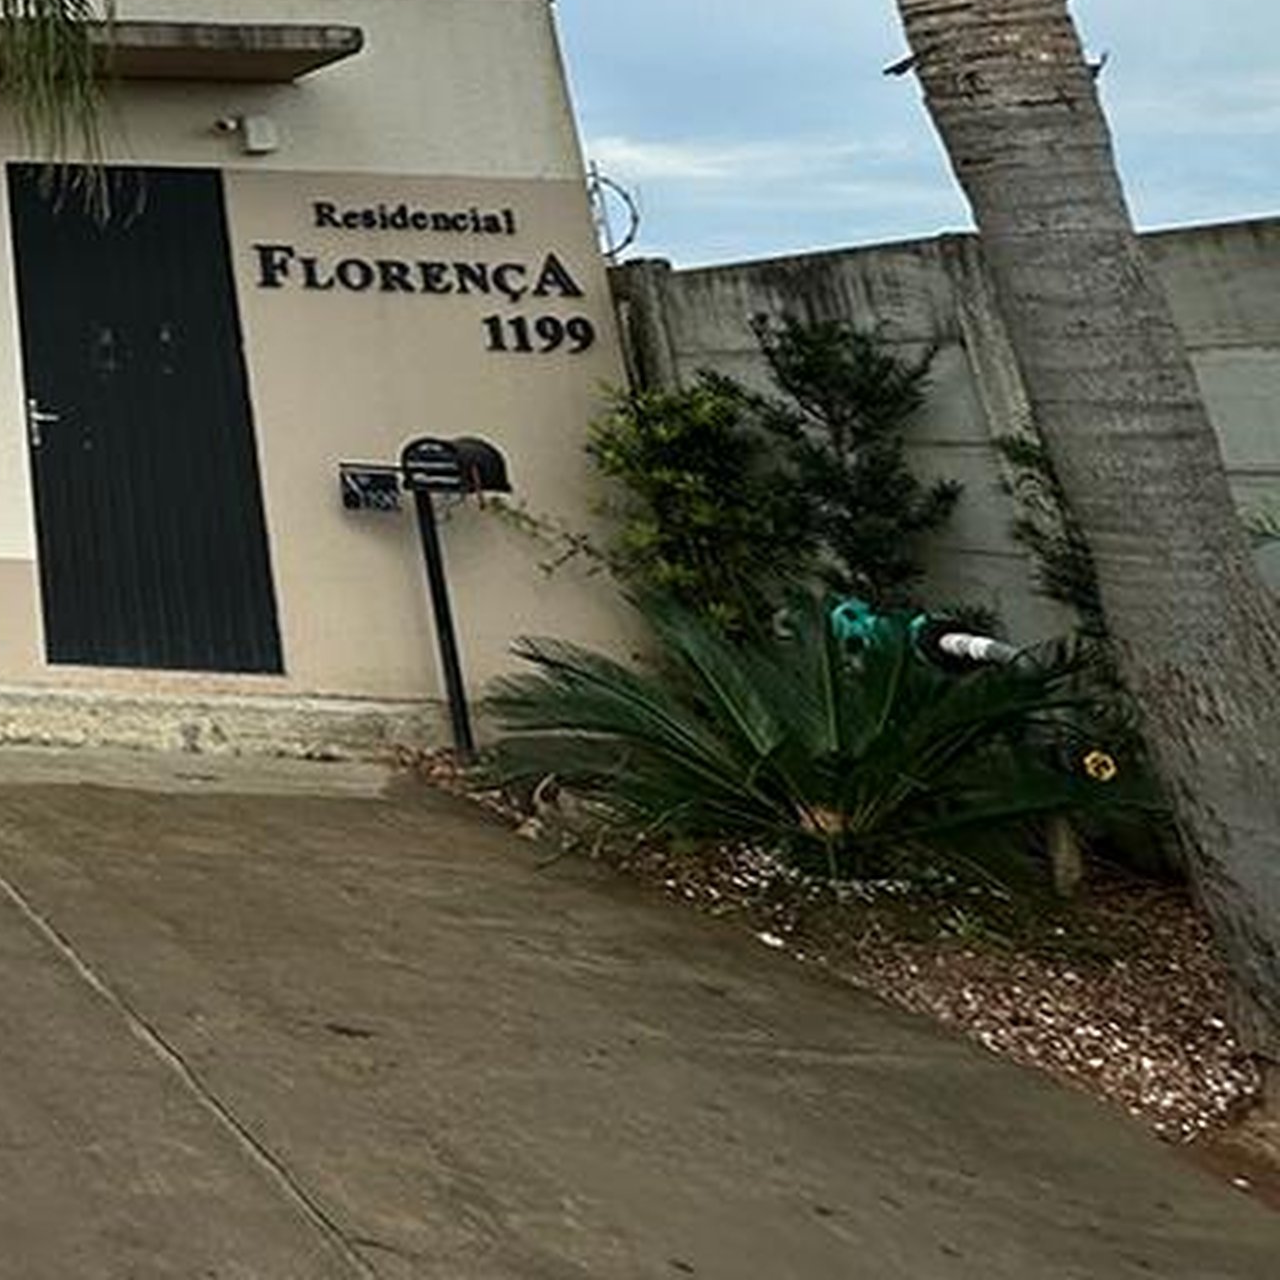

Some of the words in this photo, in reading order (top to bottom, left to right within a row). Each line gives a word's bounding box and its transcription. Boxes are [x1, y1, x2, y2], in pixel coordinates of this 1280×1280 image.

[312, 201, 517, 235] Residencial
[253, 243, 585, 303] FLORENÇA
[482, 314, 596, 354] 1199
